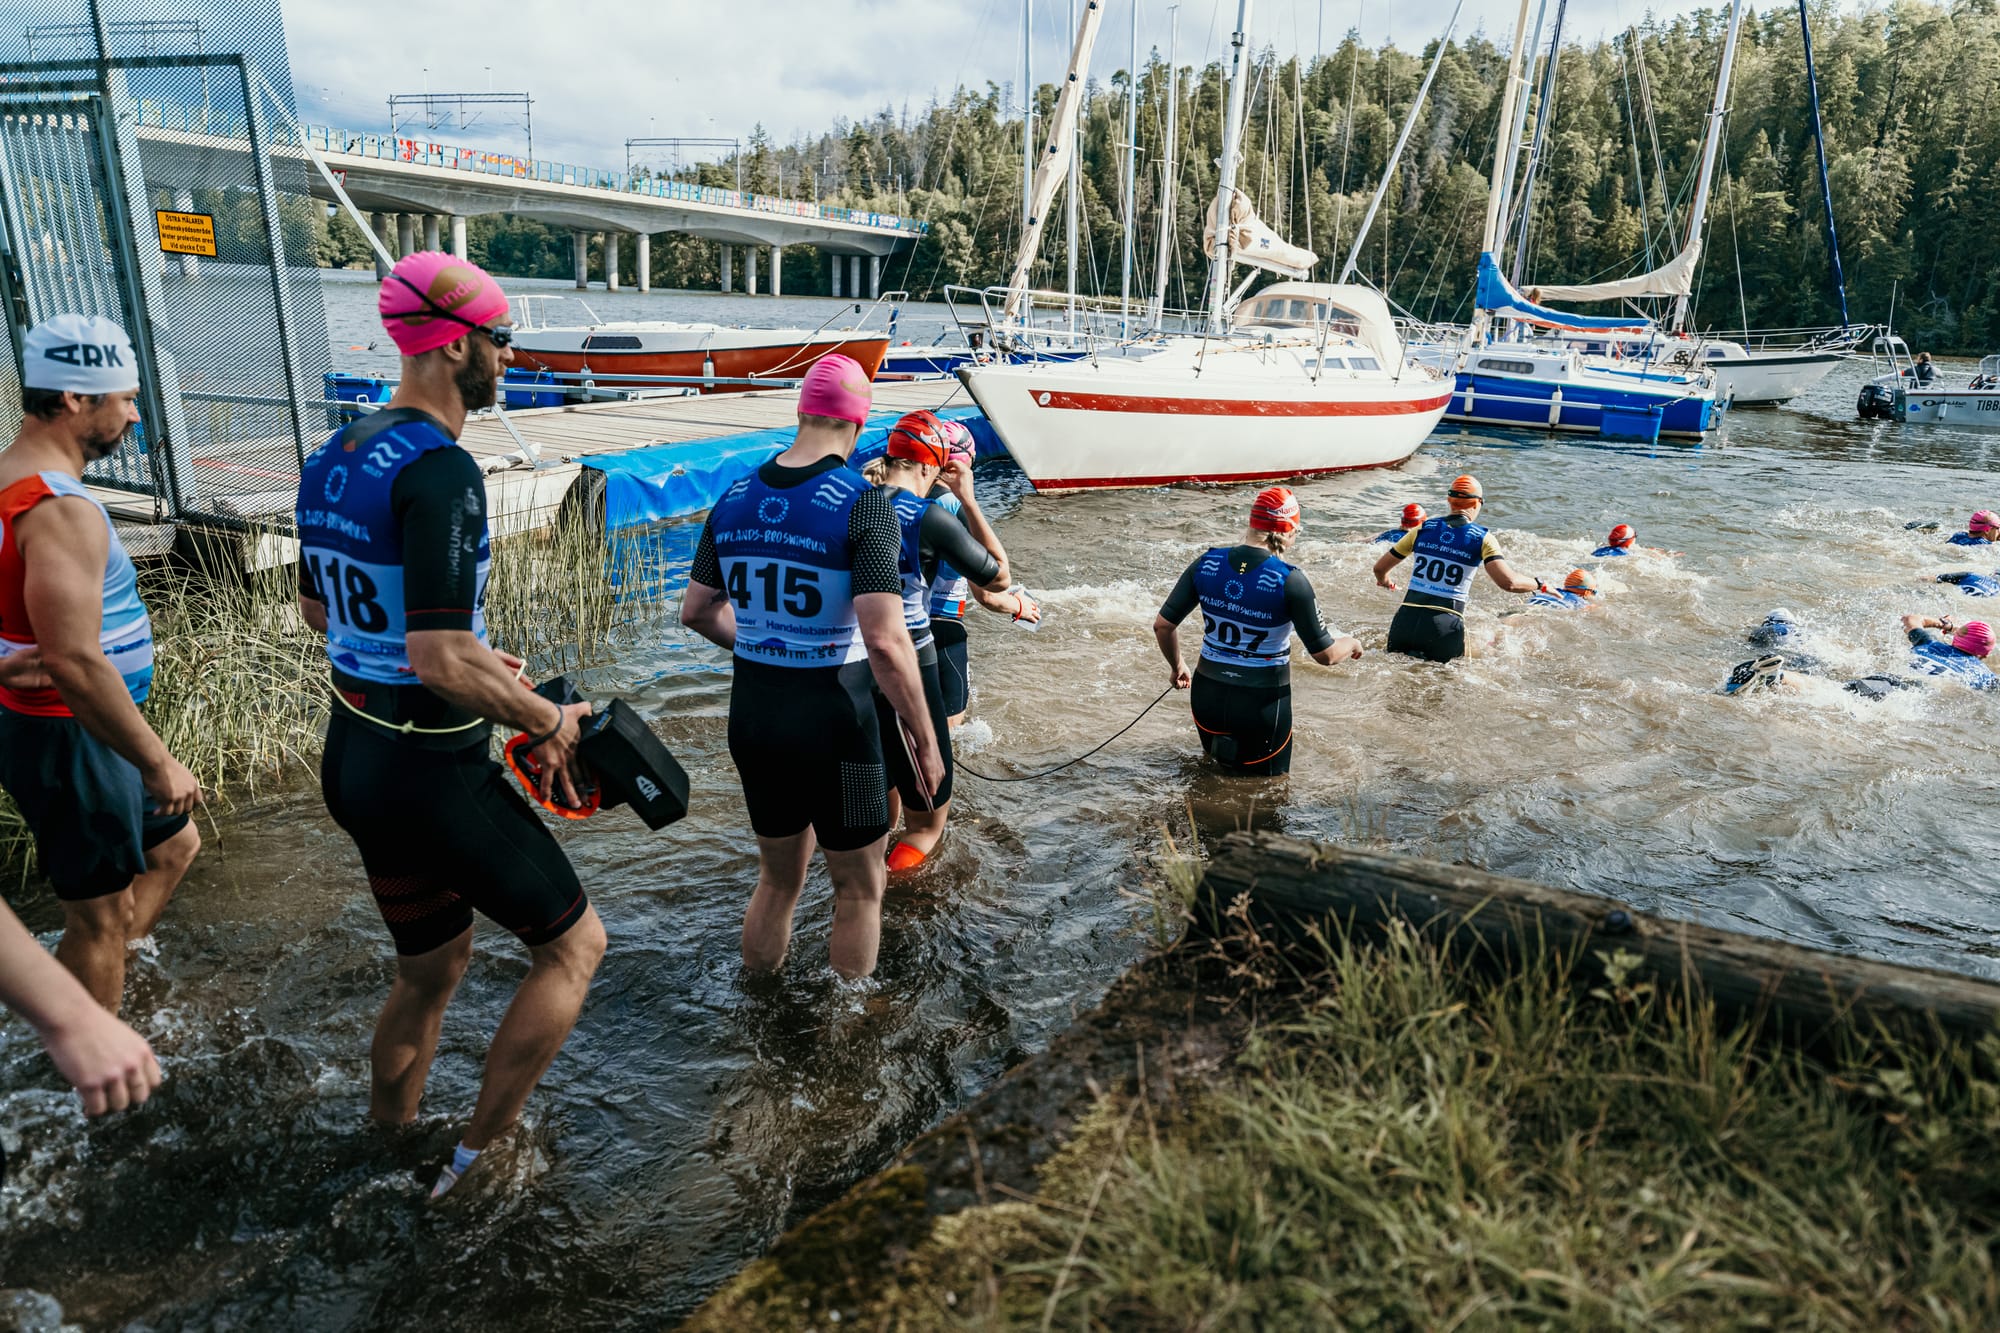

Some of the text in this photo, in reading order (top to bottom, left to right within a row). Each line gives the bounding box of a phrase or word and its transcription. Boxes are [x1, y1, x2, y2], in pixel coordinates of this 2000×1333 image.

[165, 213, 204, 224] ÖSTRA MÄLAREN
[44, 343, 124, 368] ARK
[1976, 400, 2000, 411] TIBB
[1412, 555, 1464, 586] 209
[310, 554, 389, 634] 418
[727, 562, 823, 619] 415
[766, 619, 853, 636] Handelsbanken
[1203, 613, 1269, 653] 207
[635, 774, 663, 802] ARK
